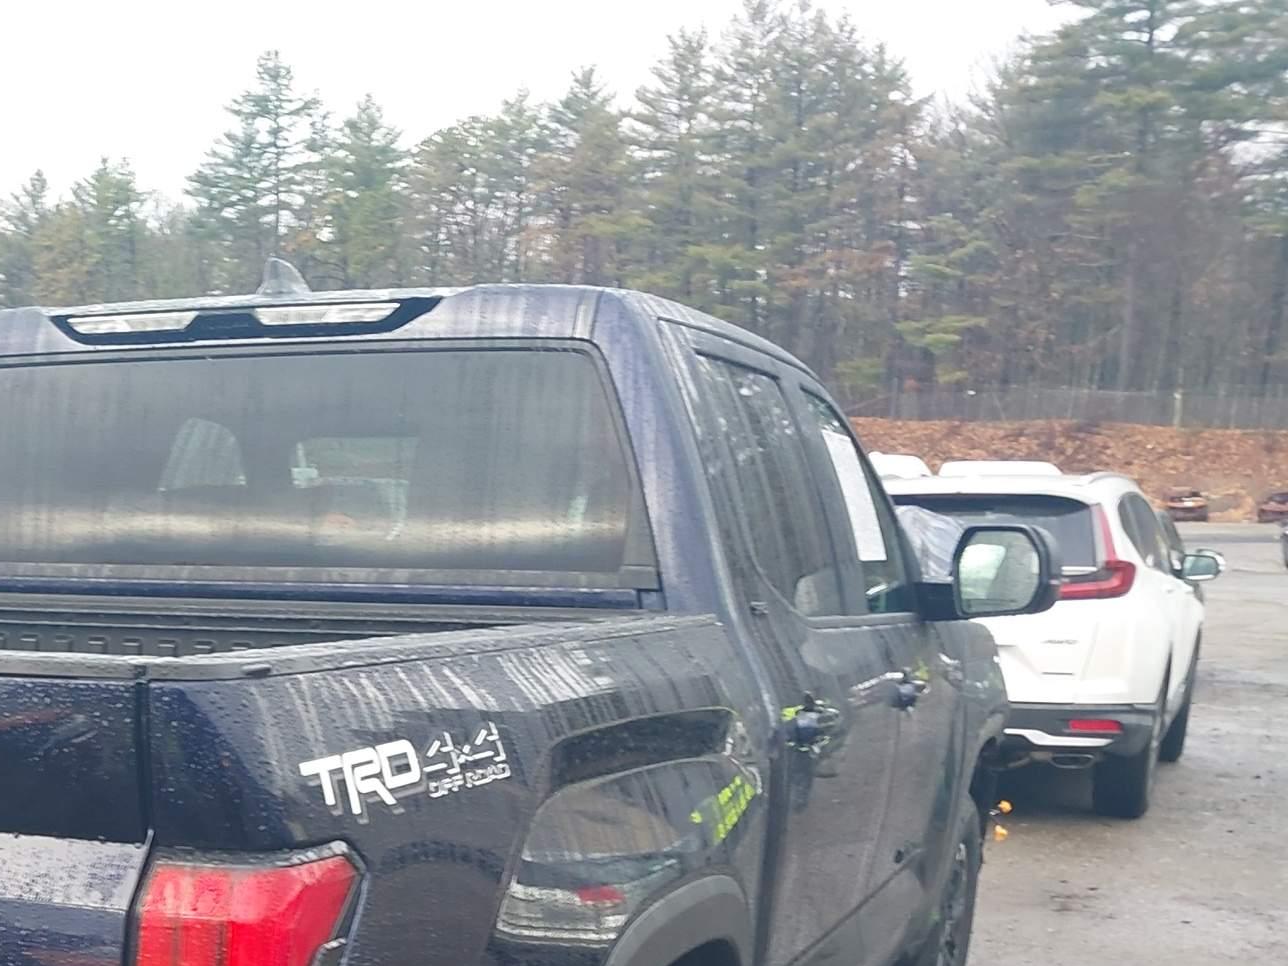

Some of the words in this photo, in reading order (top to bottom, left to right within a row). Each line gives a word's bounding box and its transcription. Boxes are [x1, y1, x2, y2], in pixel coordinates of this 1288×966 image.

[298, 738, 422, 815] TRD
[428, 773, 465, 798] OFF
[465, 763, 512, 788] ROAD
